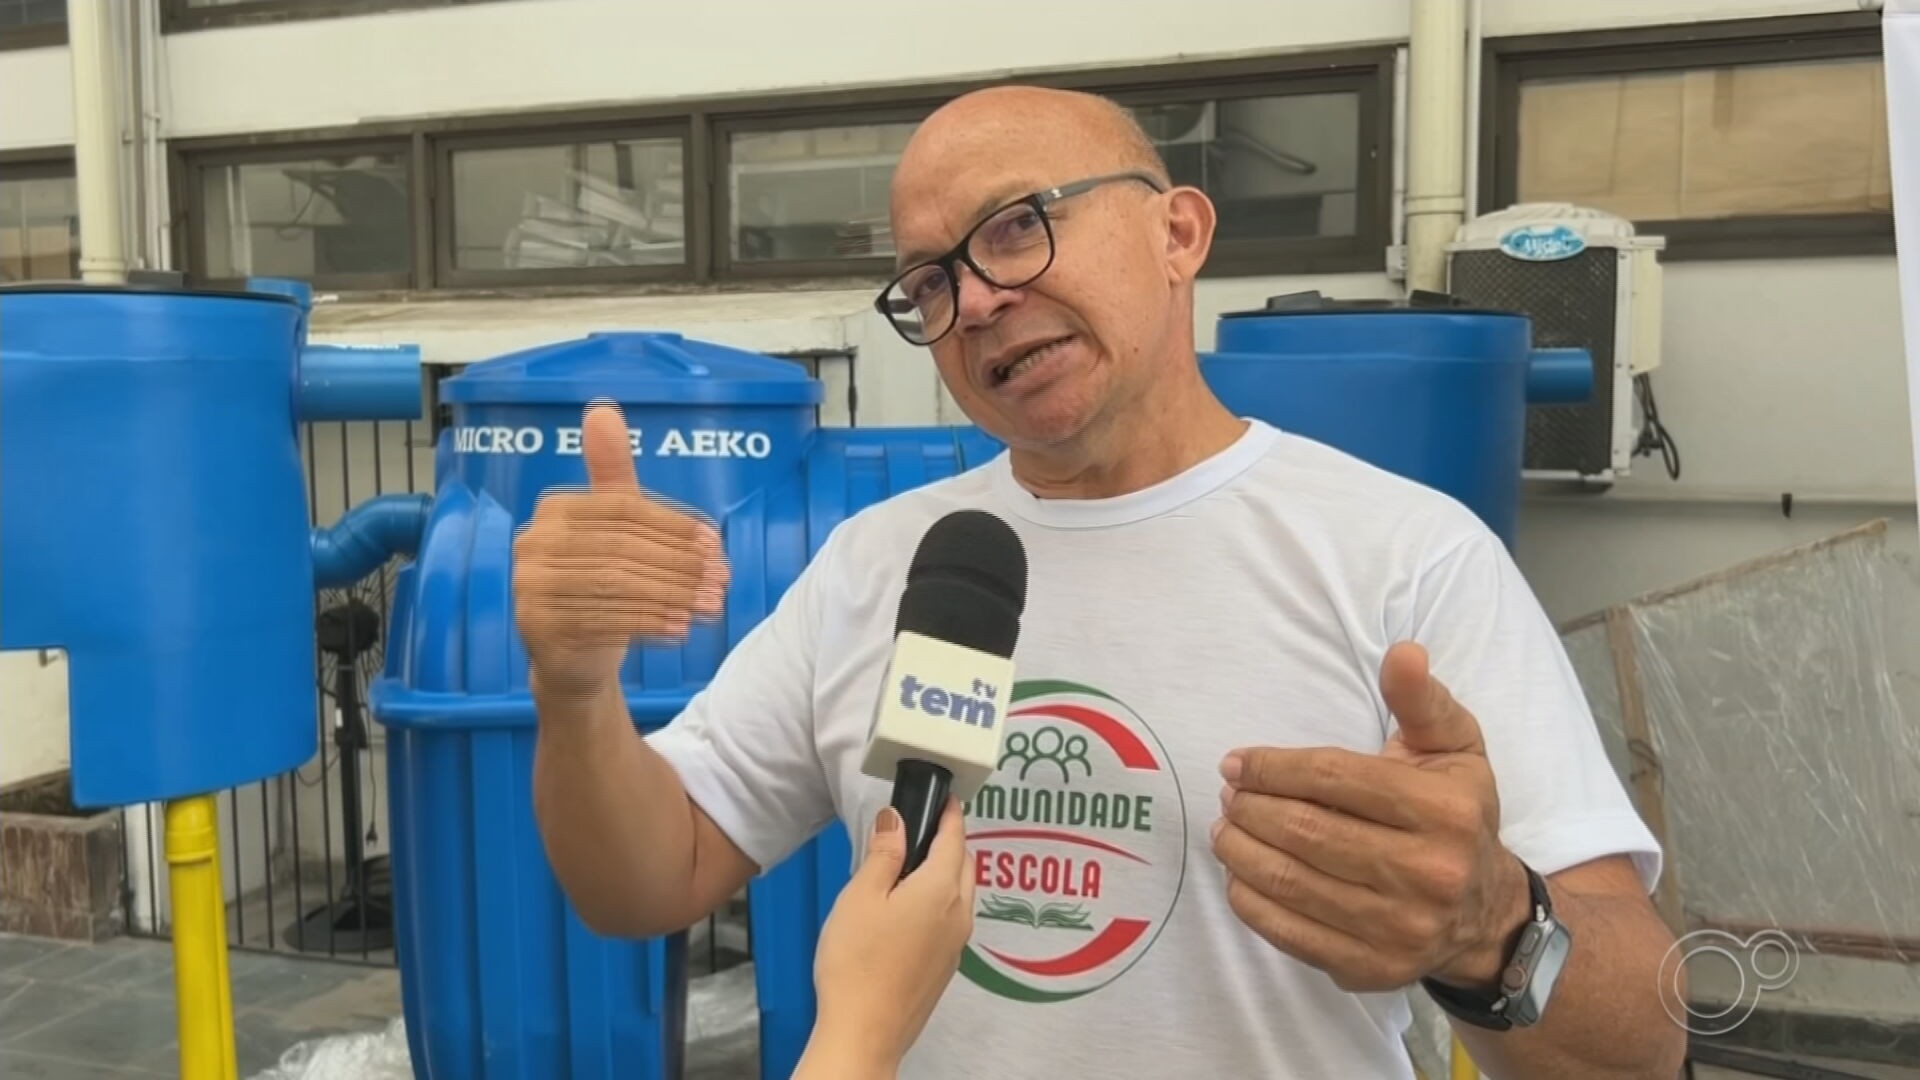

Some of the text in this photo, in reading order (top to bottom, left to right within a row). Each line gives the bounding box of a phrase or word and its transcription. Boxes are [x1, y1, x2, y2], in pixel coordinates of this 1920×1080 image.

[454, 426, 772, 459] MICRO EE AEKO
[900, 673, 996, 730] tem
[971, 677, 998, 699] tv
[963, 784, 1153, 832] MUNIDADE
[975, 849, 1102, 898] ESCOLA
